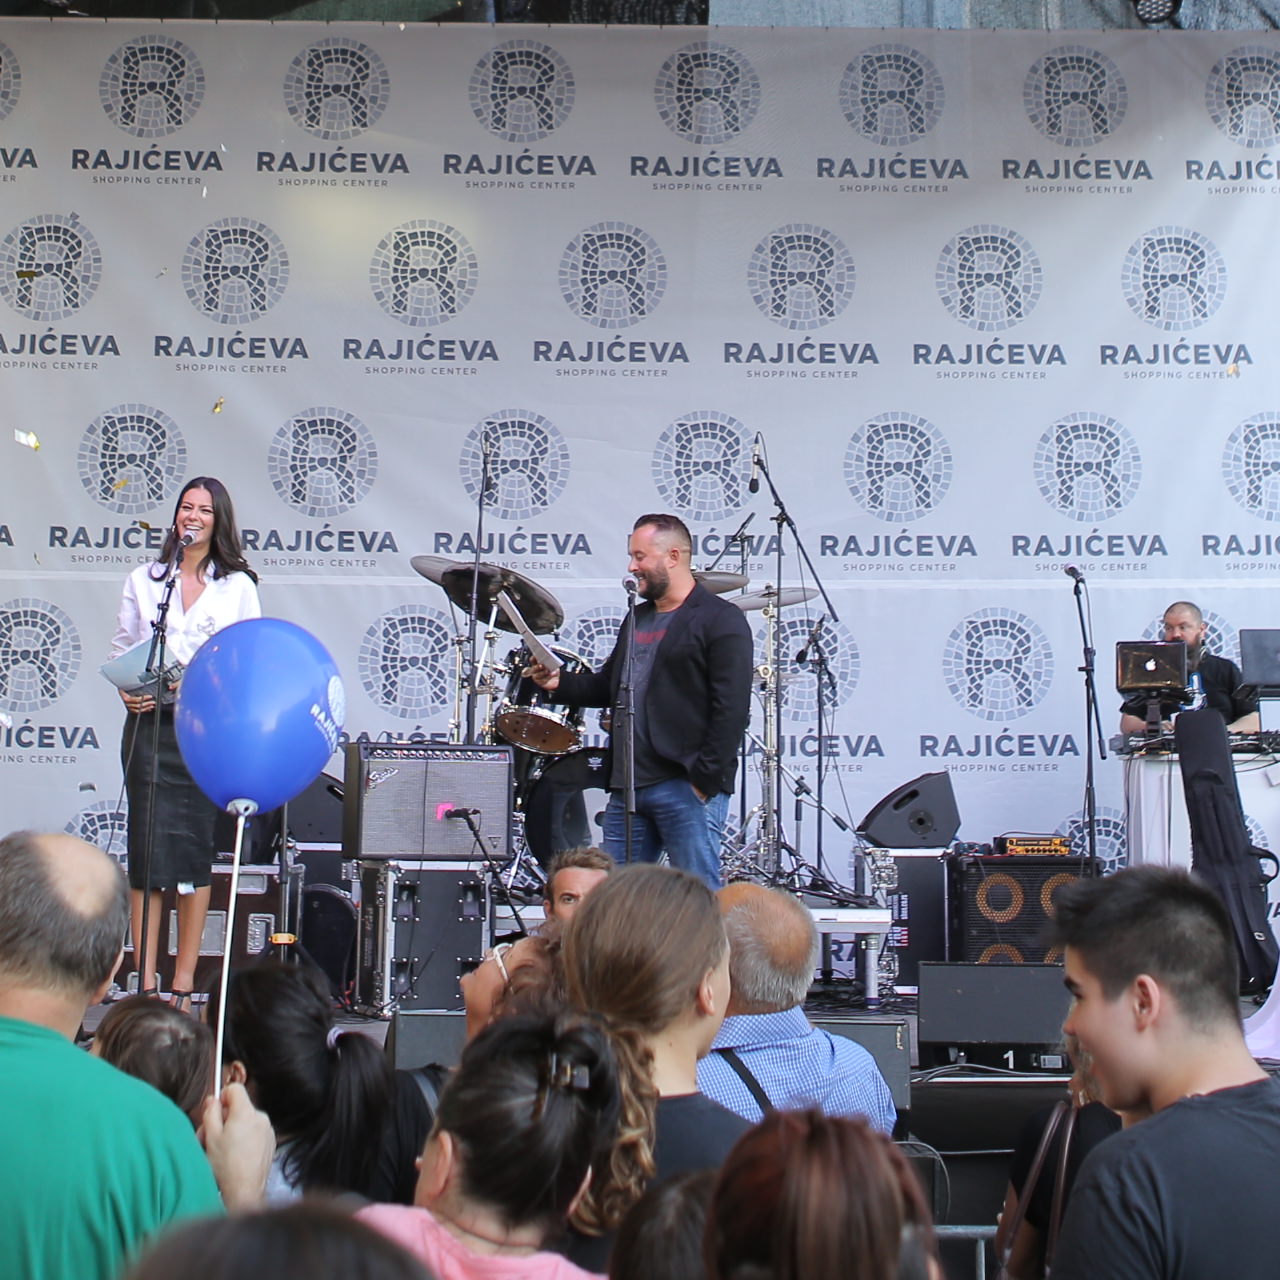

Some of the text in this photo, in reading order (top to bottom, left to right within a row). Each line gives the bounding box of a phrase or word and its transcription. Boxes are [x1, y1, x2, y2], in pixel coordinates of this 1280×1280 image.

[72, 144, 223, 171] RAJIĆEVA
[257, 146, 409, 173] RAJIĆEVA
[444, 148, 596, 175] RAJIĆEVA
[631, 151, 783, 177] RAJIĆEVA
[817, 152, 968, 179] RAJIĆEVA
[1003, 153, 1153, 180] RAJIĆEVA
[92, 175, 203, 186] SHOPPING CENTER
[277, 177, 389, 188] SHOPPING CENTER
[464, 180, 576, 190] SHOPPING CENTER
[652, 182, 763, 192] SHOPPING CENTER
[839, 184, 949, 194] SHOPPING CENTER
[1024, 184, 1133, 195] SHOPPING CENTER
[1207, 185, 1267, 195] SHOPPING
[155, 331, 308, 358] RAJIĆEVA
[344, 333, 499, 361] RAJIĆEVA
[534, 335, 689, 362] RAJIĆEVA
[725, 336, 879, 364] RAJIĆEVA
[914, 337, 1066, 365] RAJIĆEVA
[1101, 337, 1252, 365] RAJIĆEVA
[52, 361, 99, 371] CENTER
[175, 362, 287, 374] SHOPPING CENTER
[364, 366, 478, 376] SHOPPING CENTER
[555, 368, 668, 378] SHOPPING CENTER
[746, 369, 859, 379] SHOPPING CENTER
[935, 370, 1047, 380] SHOPPING CENTER
[1123, 370, 1233, 380] SHOPPING CENTER
[49, 520, 167, 549] RAJIĆE
[243, 524, 398, 553] RAJIĆEVA
[433, 526, 592, 555] RAJIĆEVA
[821, 529, 977, 556] RAJIĆEVA
[1012, 528, 1168, 556] RAJIĆEVA
[69, 553, 133, 564] SHOPPING
[262, 557, 377, 568] SHOPPING CENTER
[523, 561, 571, 571] CENTER
[842, 562, 957, 572] SHOPPING CENTER
[1100, 562, 1148, 572] CENTER
[920, 728, 1080, 756] RAJIĆEVA
[28, 754, 77, 765] CENTER
[944, 763, 1059, 773] SHOPPING CENTER
[1003, 1049, 1014, 1069] 1
